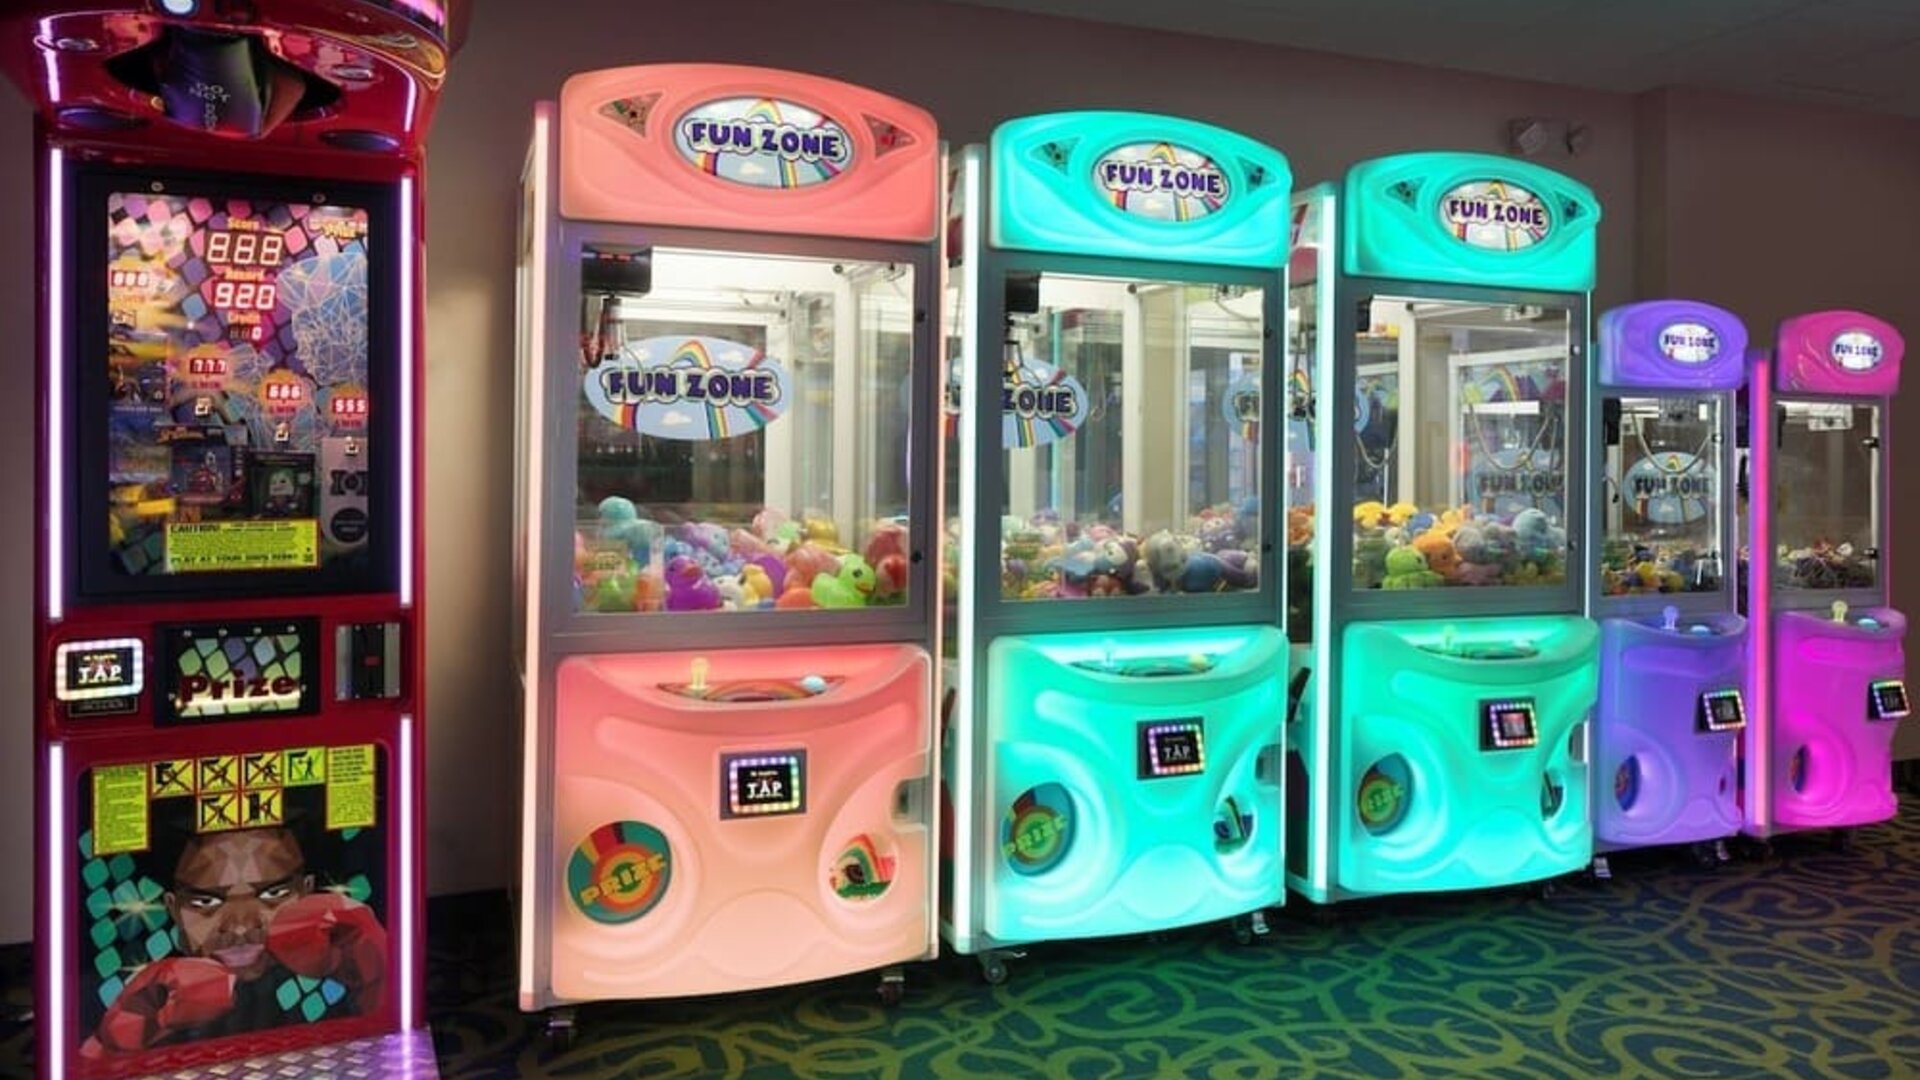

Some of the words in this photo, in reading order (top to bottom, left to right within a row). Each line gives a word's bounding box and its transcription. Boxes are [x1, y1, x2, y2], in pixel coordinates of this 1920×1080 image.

[691, 123, 752, 148] FUN
[761, 130, 840, 157] ZONE
[1106, 164, 1153, 185] FUN
[1160, 170, 1220, 193] ZONE
[1450, 200, 1488, 219] FUN
[1493, 204, 1543, 225] ZONE
[215, 282, 276, 310] 920
[608, 372, 677, 396] FUN
[687, 373, 773, 399] ZONE
[1635, 476, 1667, 492] FUN
[78, 664, 122, 684] TAP
[179, 669, 298, 703] Prize
[746, 779, 783, 799] TAP
[581, 853, 666, 905] PRIZE
